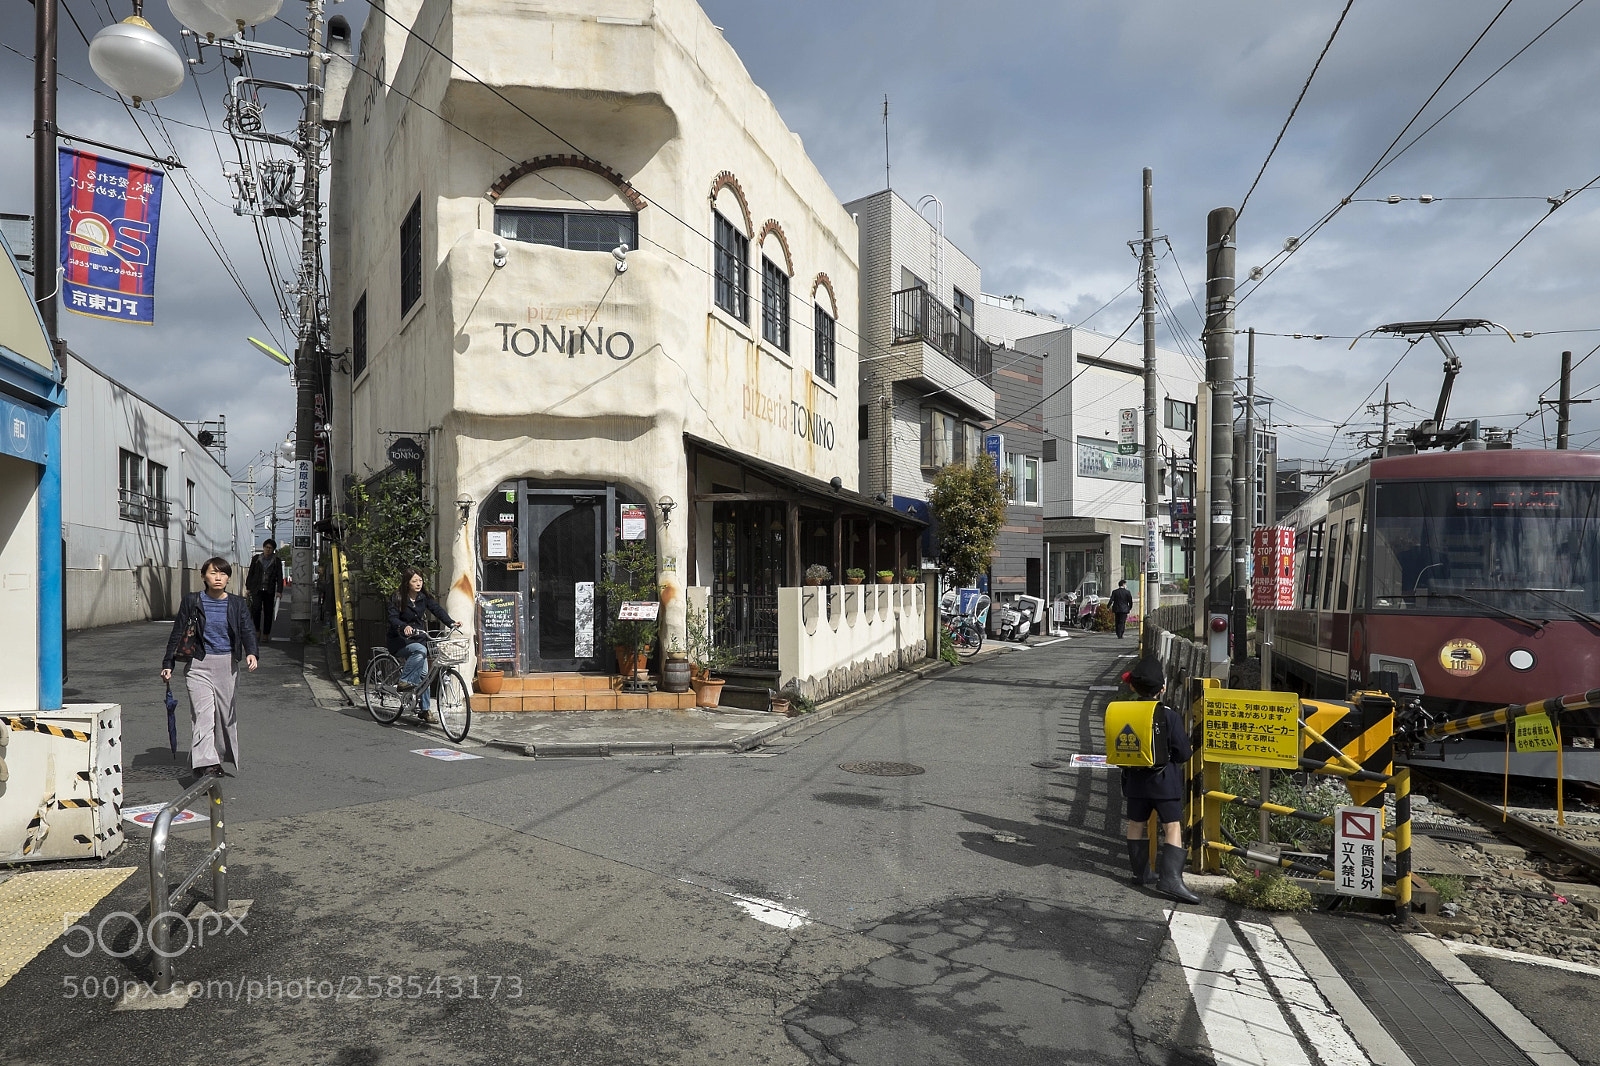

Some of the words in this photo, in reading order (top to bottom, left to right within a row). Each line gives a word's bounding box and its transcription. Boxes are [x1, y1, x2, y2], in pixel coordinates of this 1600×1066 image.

[527, 302, 599, 324] pizzeria
[494, 323, 635, 360] TONINO
[742, 378, 788, 431] pizzeria
[791, 400, 835, 451] TONINO
[13, 418, 26, 439] 南口
[391, 451, 420, 460] TONINO
[298, 461, 309, 508] 松原皮フ科
[1257, 547, 1273, 556] STOP
[1281, 547, 1293, 556] STOP
[1257, 586, 1272, 594] ボタン
[1280, 586, 1291, 594] ボタン
[1207, 701, 1292, 714] 踏切には、列車の車輪が
[1206, 709, 1286, 721] 通過する溝があります。
[1206, 731, 1279, 743] などで通行する際は、
[1517, 738, 1554, 748] おやめ下さい
[1206, 739, 1279, 754] 溝に注意して下さい。
[1341, 841, 1355, 889] 立入禁止
[1361, 843, 1375, 892] 係員以外
